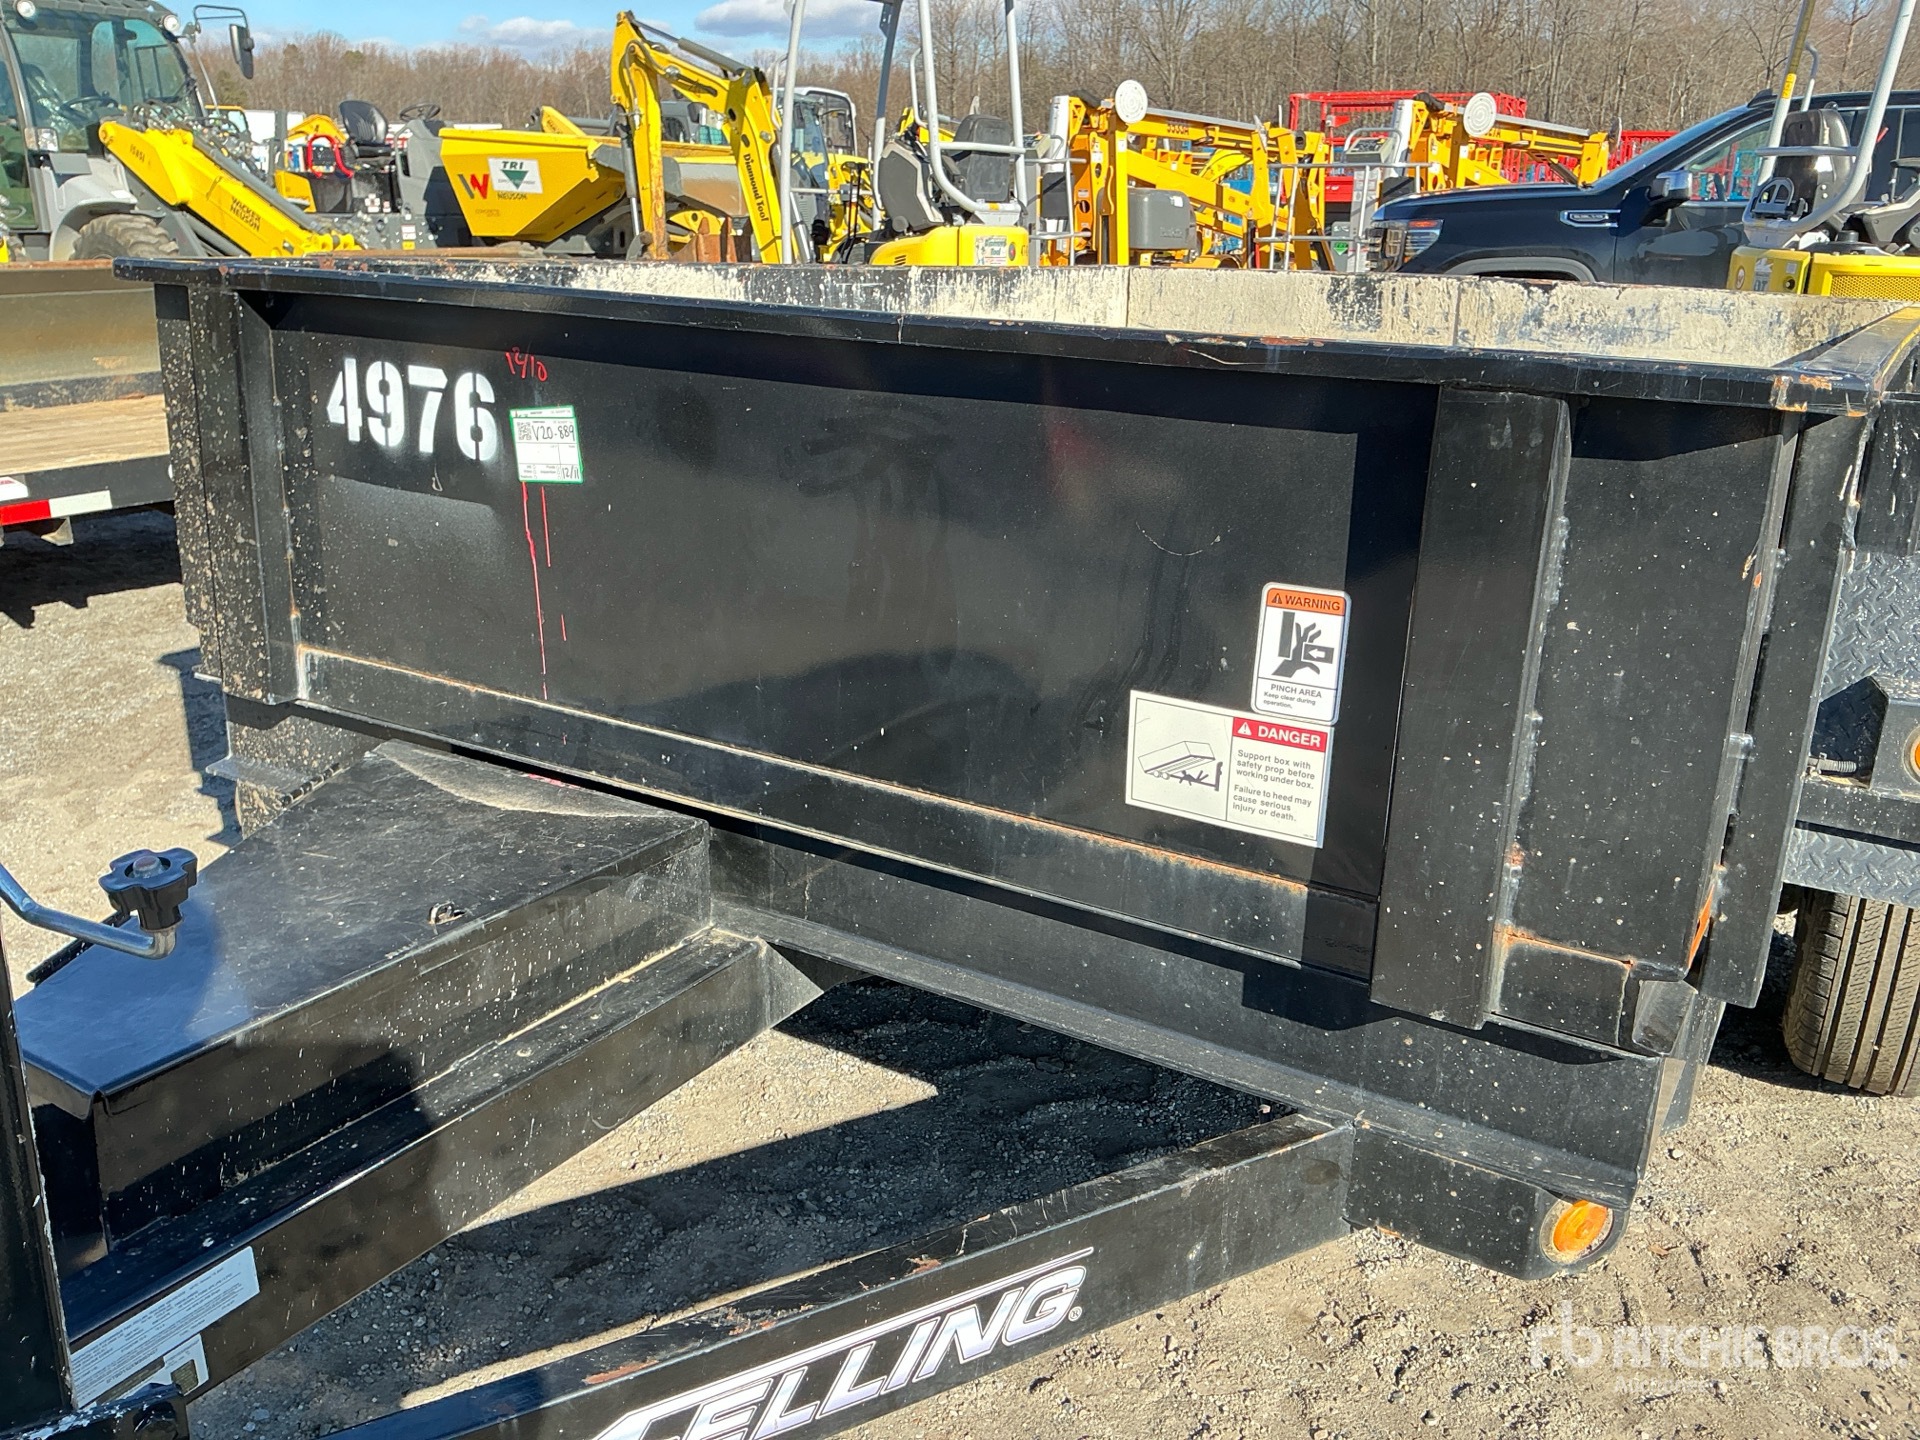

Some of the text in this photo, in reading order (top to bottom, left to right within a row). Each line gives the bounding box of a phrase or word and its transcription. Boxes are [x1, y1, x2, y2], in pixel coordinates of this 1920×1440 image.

[502, 161, 524, 170] TRI
[743, 153, 770, 222] Diamond Tool
[229, 206, 261, 233] NEUSON
[231, 196, 262, 222] WACKER
[326, 357, 498, 461] 4976
[532, 424, 576, 442] V20-889
[1285, 594, 1341, 611] WARNING
[1263, 691, 1316, 706] Keep clear during
[1270, 683, 1322, 698] PINCH AREA
[1263, 699, 1293, 709] operation.
[1257, 725, 1321, 748] DANGER
[1236, 758, 1315, 781] safety prop before
[1237, 749, 1312, 770] Support box with
[1236, 769, 1314, 790] working under box.
[1233, 794, 1291, 811] cause serious
[1234, 784, 1312, 808] Failure to heed may
[1232, 802, 1297, 822] injury or death.
